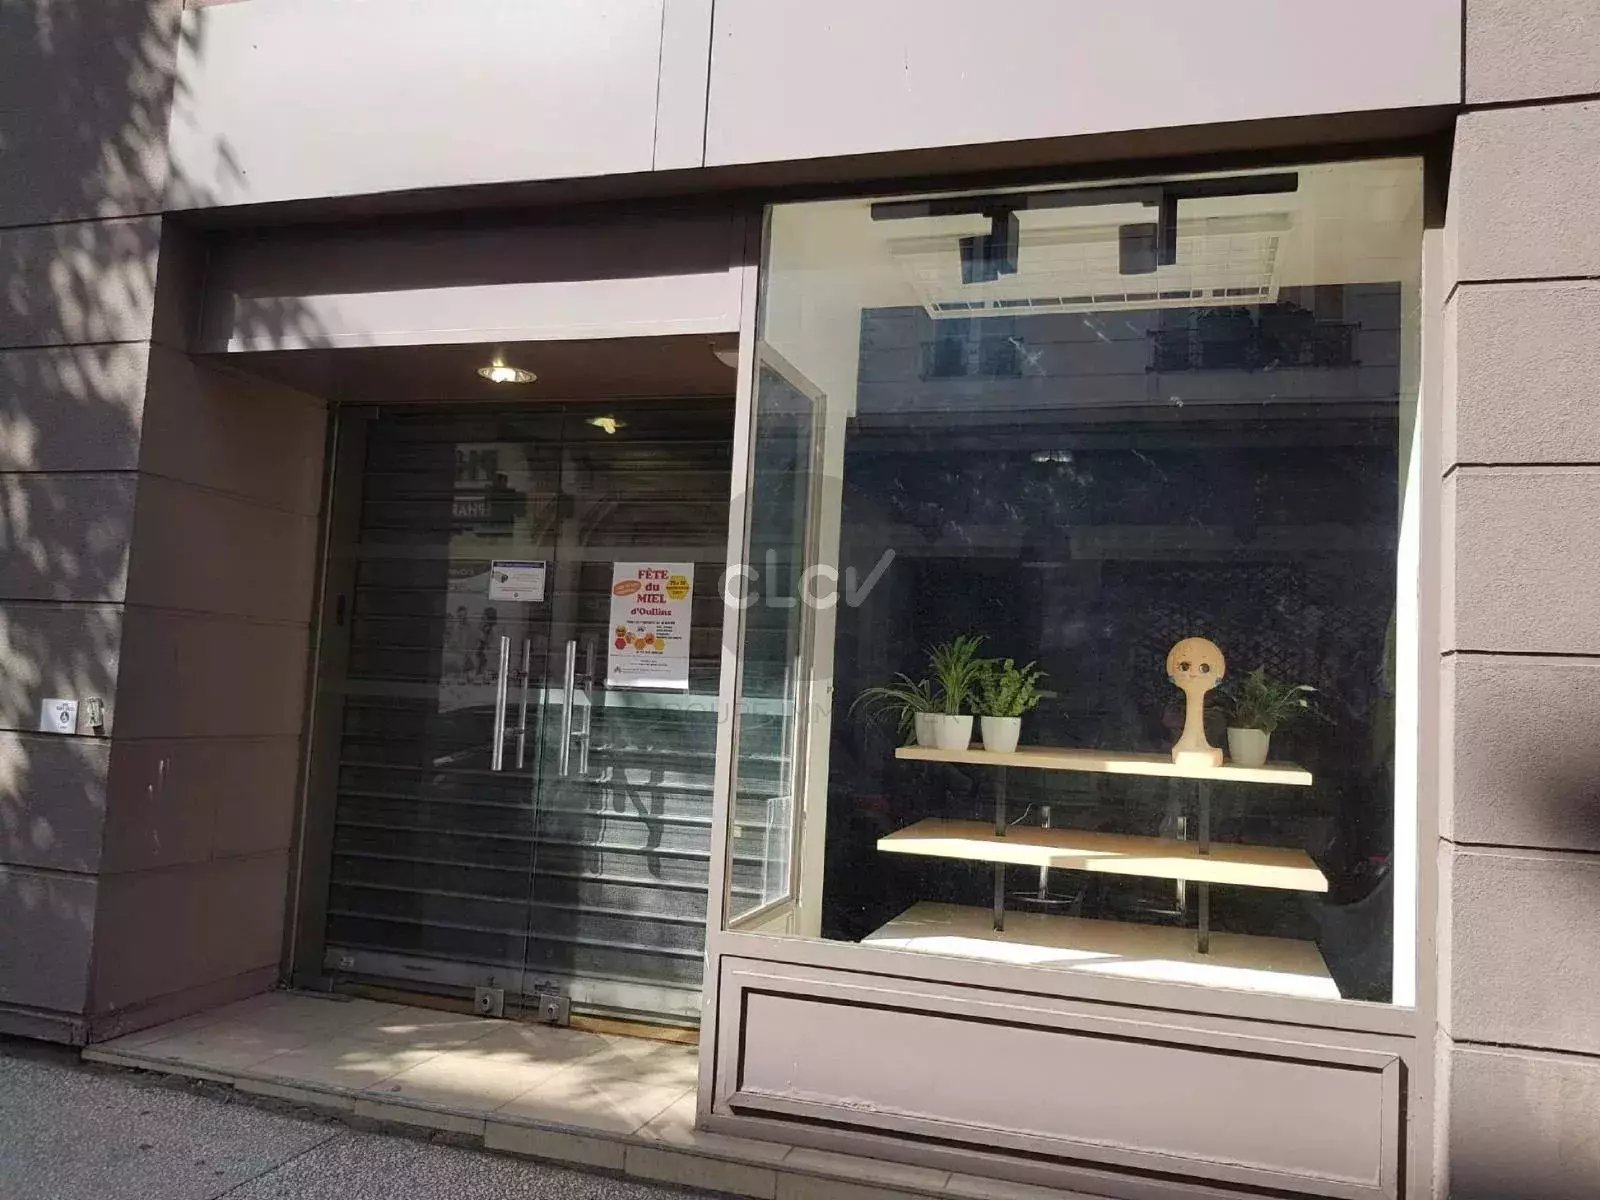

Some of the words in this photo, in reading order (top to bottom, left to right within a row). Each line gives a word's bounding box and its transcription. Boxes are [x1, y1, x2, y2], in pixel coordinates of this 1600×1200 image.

[638, 568, 669, 580] FÊTE
[645, 583, 660, 592] du
[636, 594, 667, 604] MIEL
